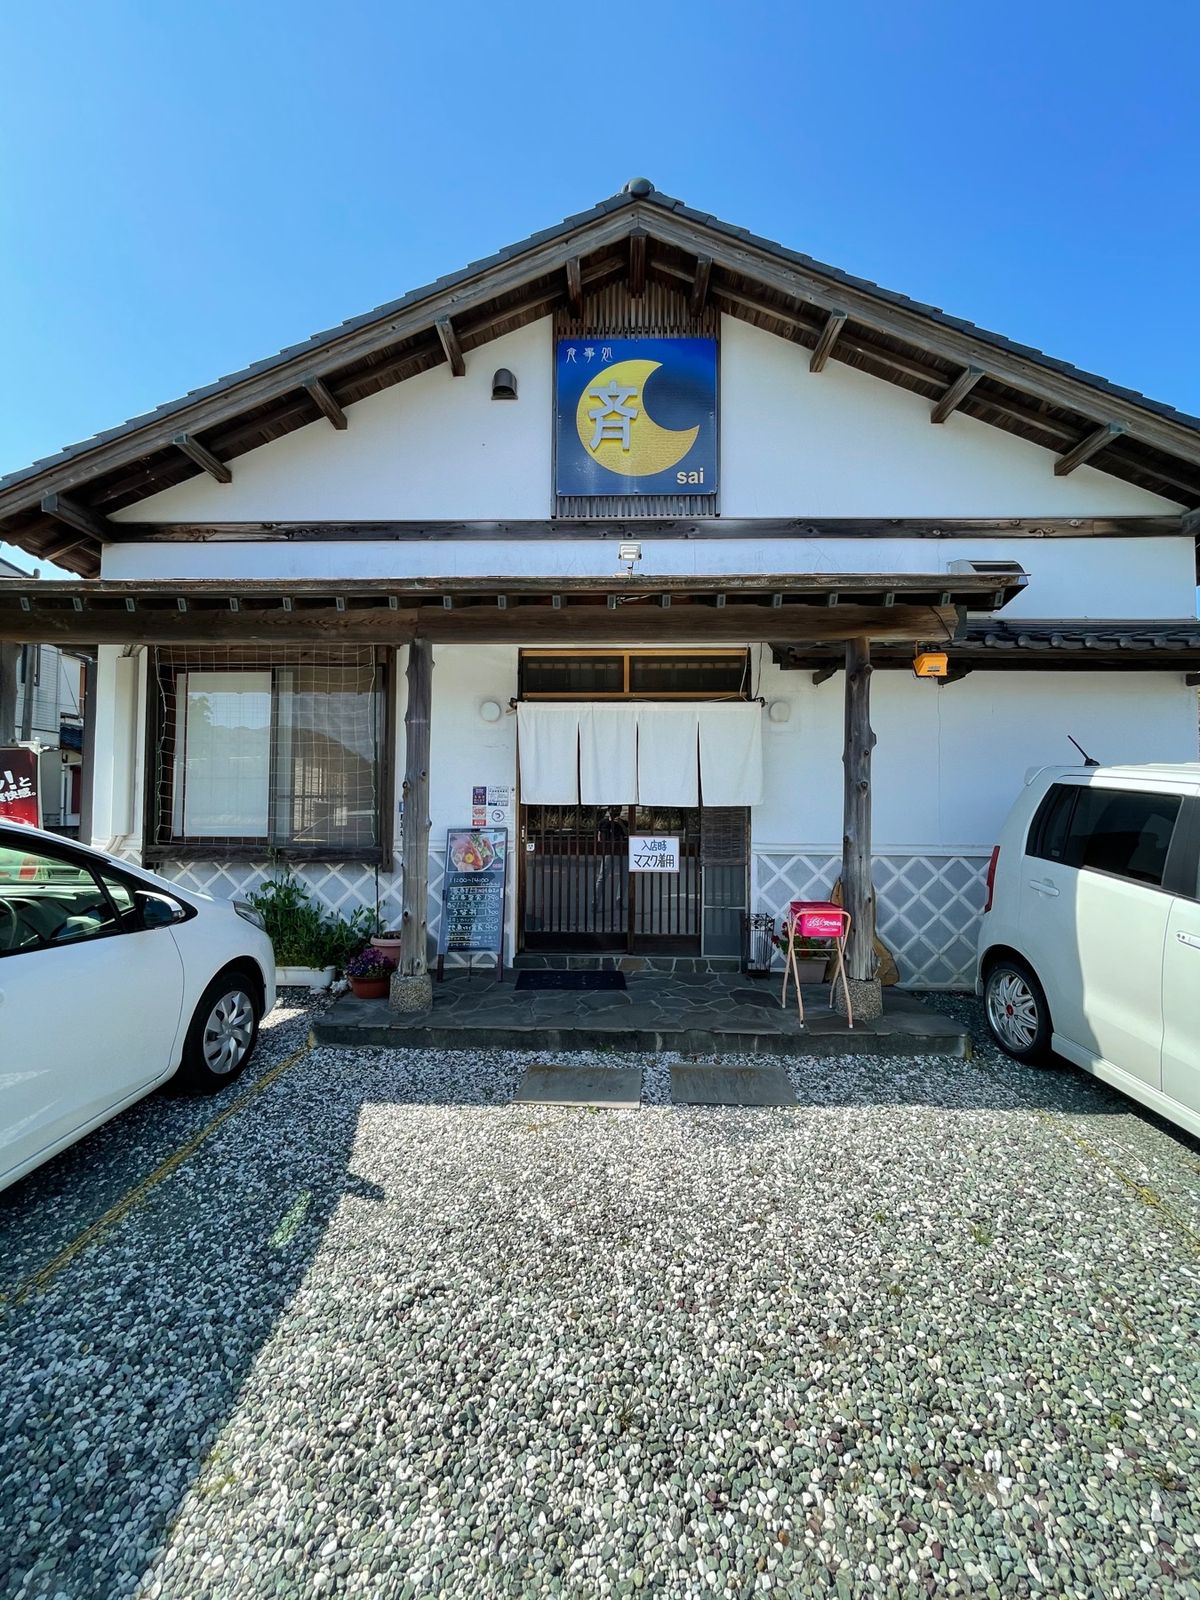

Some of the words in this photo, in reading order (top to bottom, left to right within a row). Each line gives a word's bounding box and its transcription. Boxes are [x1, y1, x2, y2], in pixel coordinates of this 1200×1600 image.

[566, 347, 613, 364] 食事処
[676, 467, 704, 484] sai
[641, 839, 667, 851] 入店時
[633, 853, 674, 868] マスク着用
